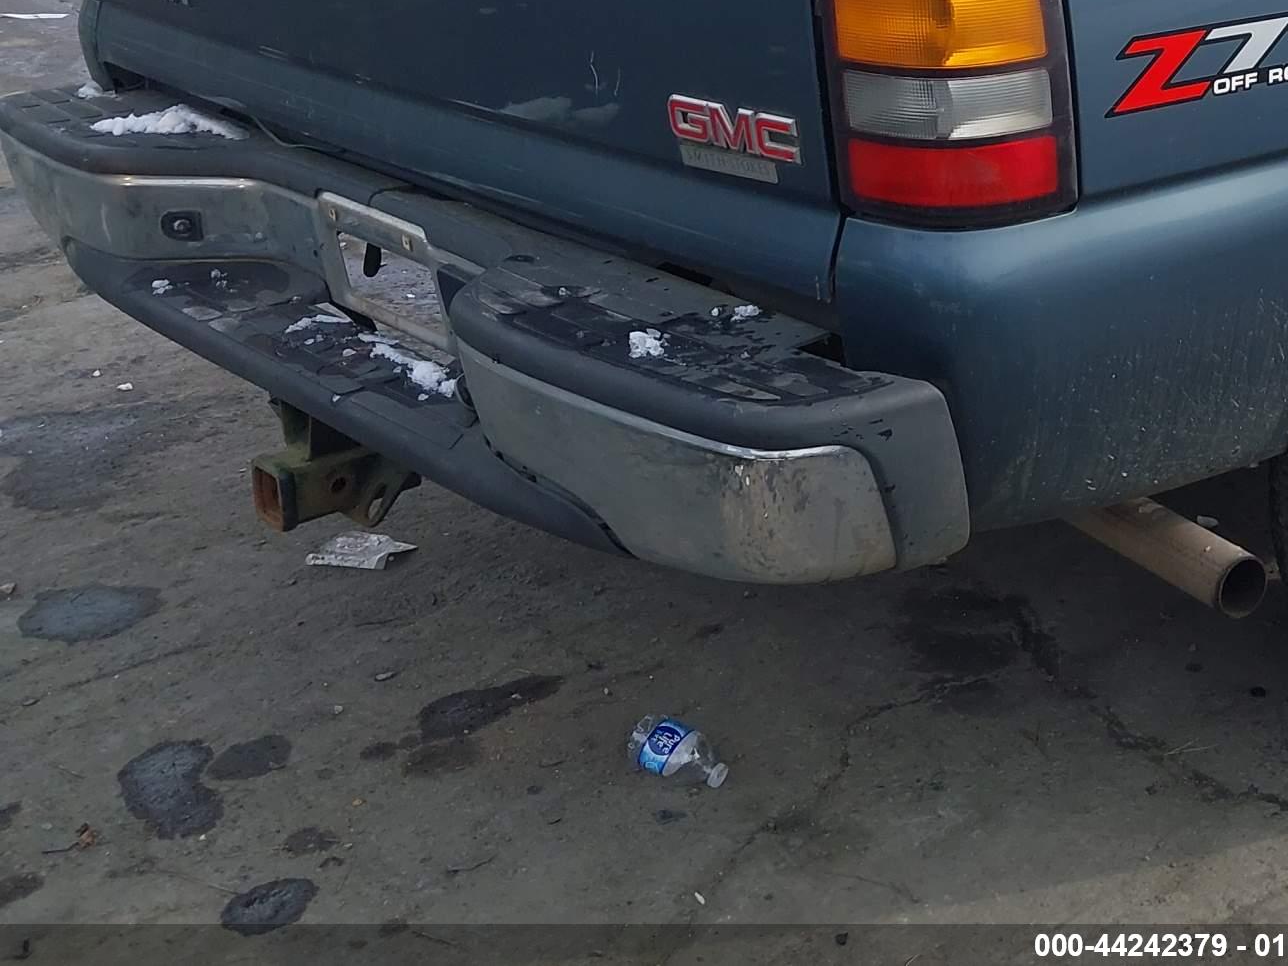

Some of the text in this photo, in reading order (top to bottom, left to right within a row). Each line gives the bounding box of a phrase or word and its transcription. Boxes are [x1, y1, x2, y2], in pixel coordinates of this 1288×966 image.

[1212, 72, 1258, 96] OFF
[667, 93, 803, 167] GMC
[662, 735, 681, 754] Pure
